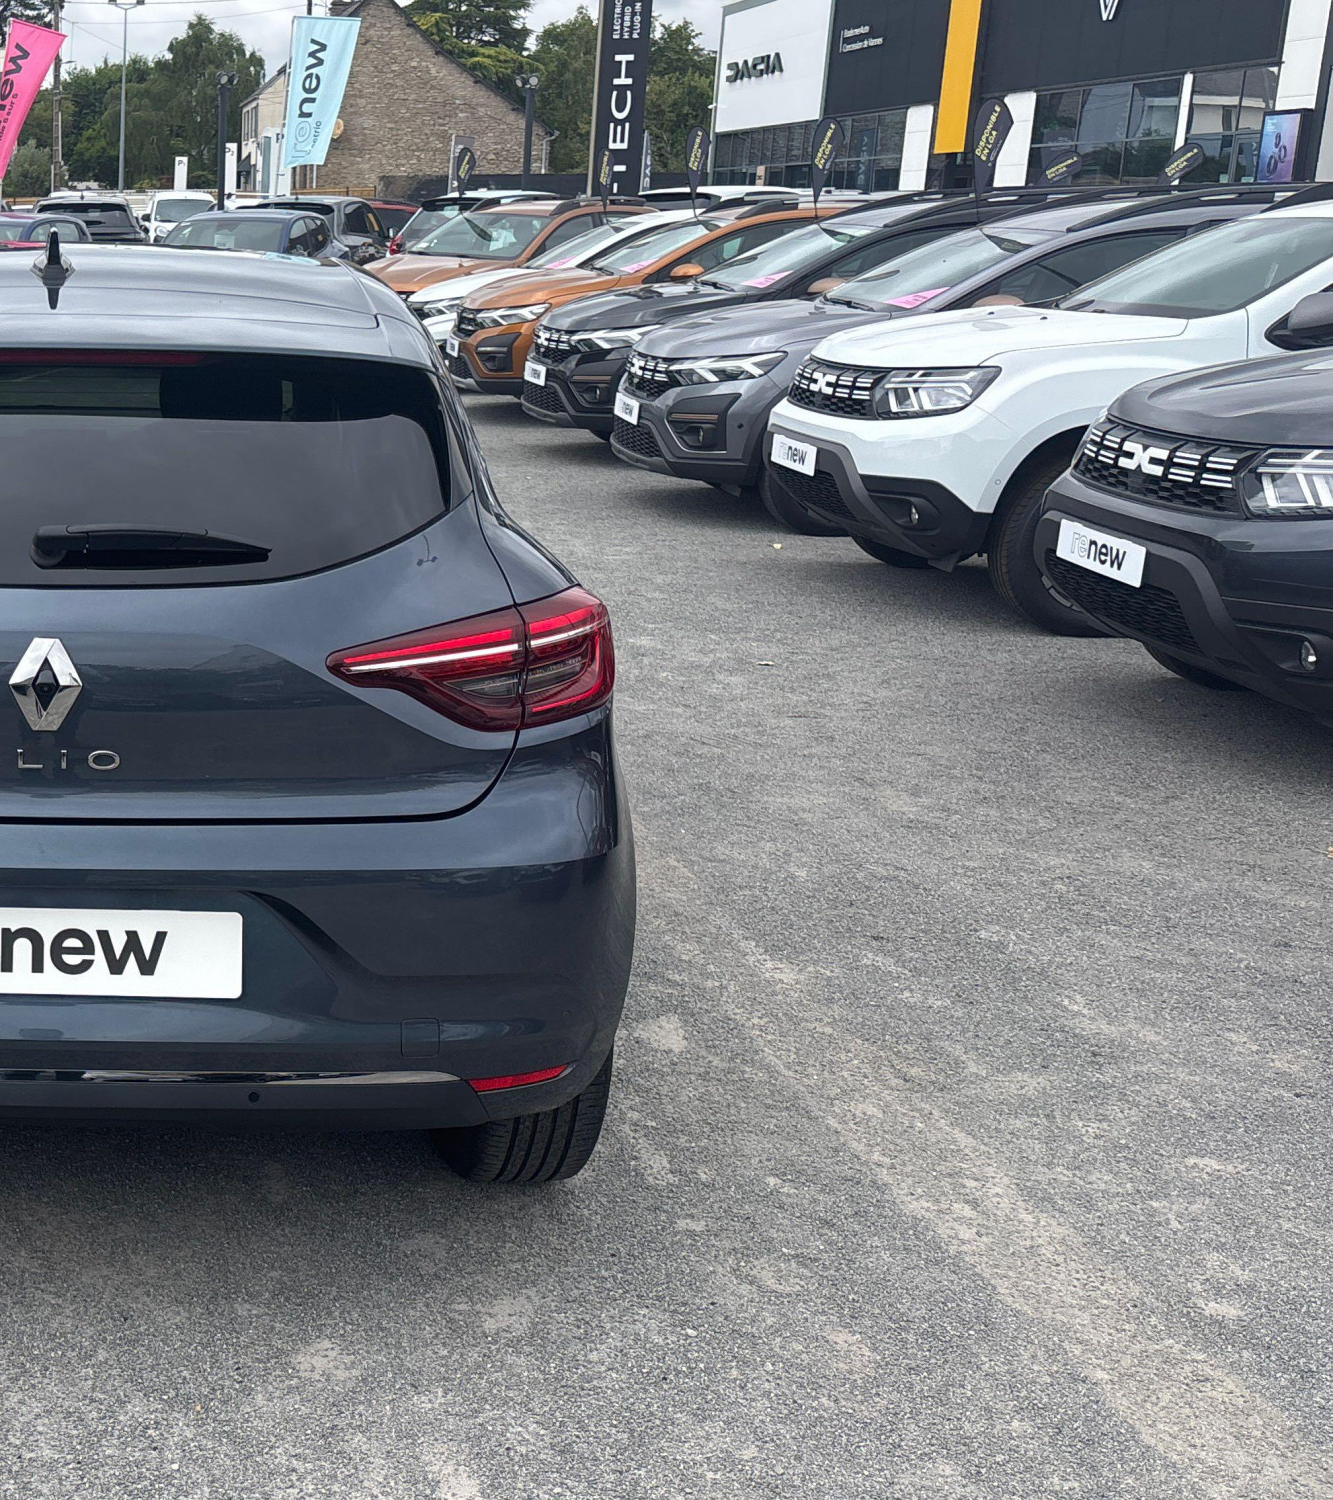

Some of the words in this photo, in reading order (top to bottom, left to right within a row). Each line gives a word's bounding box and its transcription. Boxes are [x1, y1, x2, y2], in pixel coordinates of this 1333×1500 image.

[623, 6, 632, 39] HYBRID
[632, 2, 642, 39] PLUG-IN
[725, 52, 784, 83] DACIA
[290, 38, 328, 160] renew
[975, 104, 1002, 157] DISPONIBLE
[980, 147, 990, 162] EN
[986, 130, 998, 149] LOA
[776, 441, 808, 467] renew
[1070, 531, 1127, 571] renew
